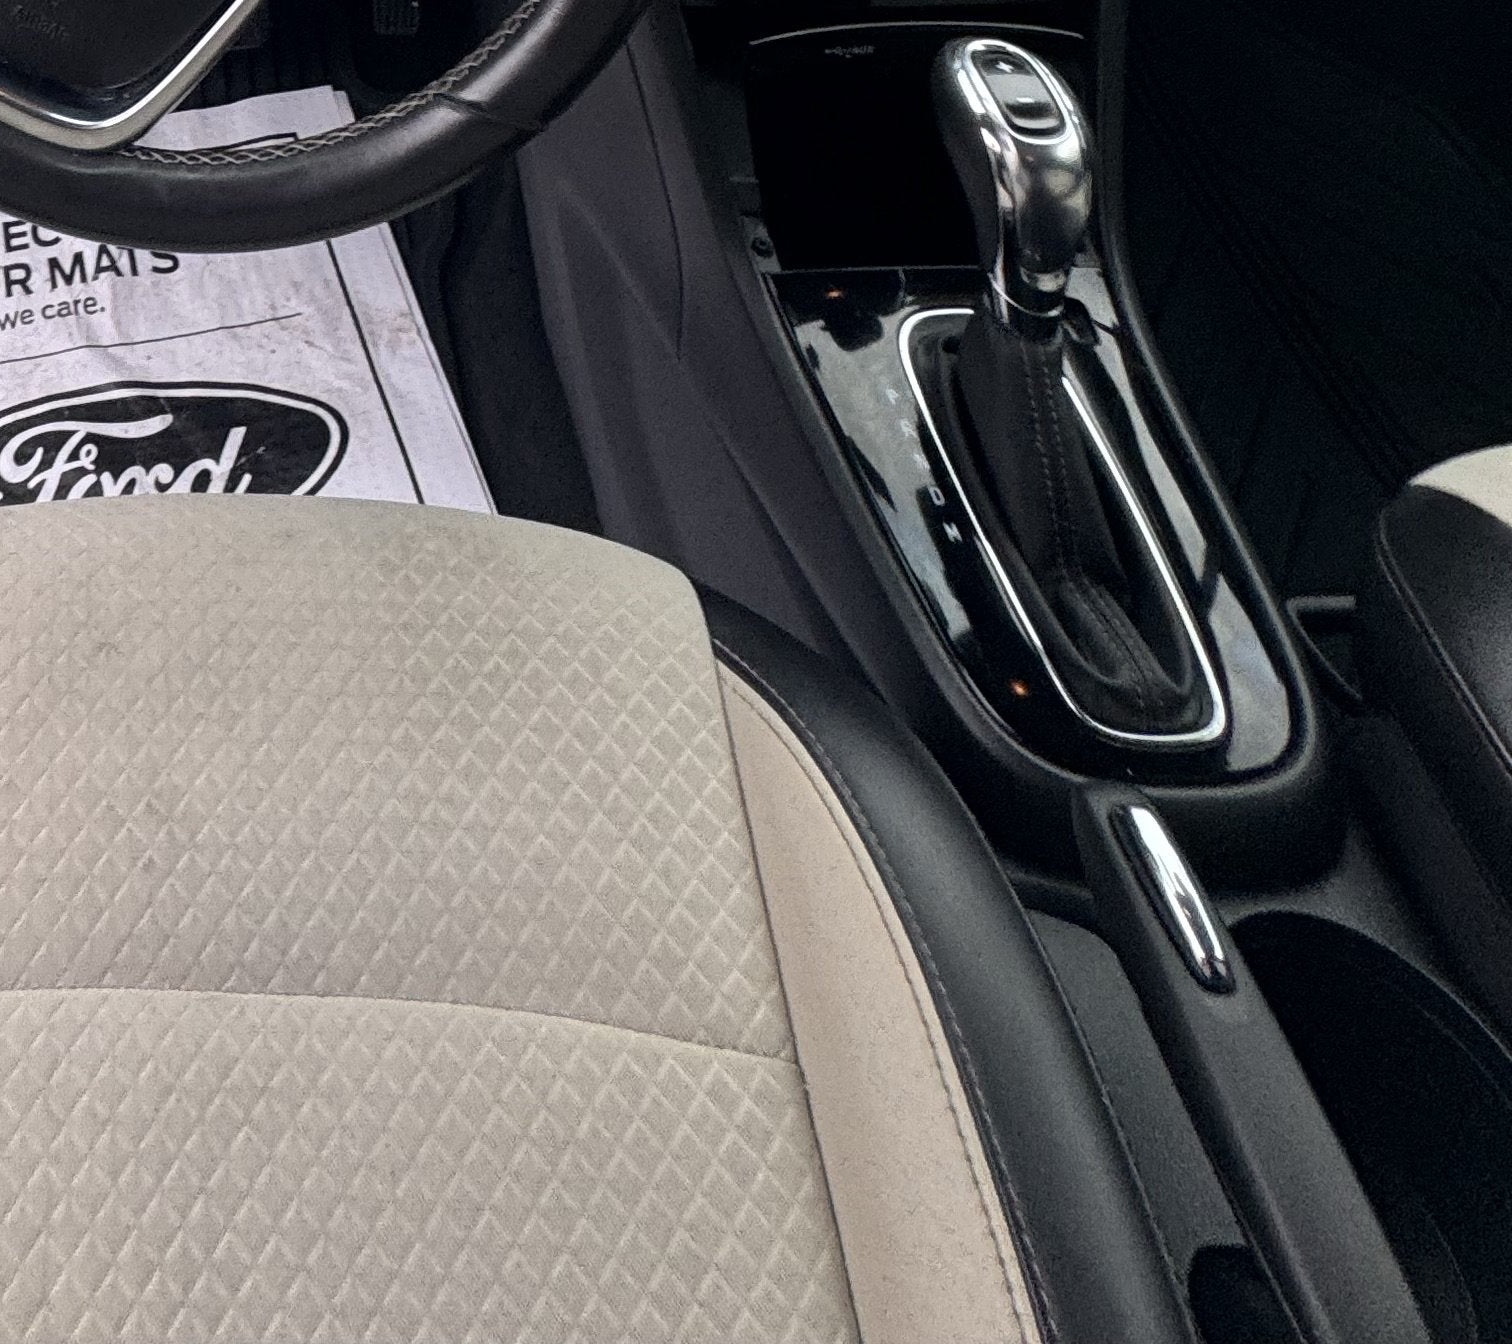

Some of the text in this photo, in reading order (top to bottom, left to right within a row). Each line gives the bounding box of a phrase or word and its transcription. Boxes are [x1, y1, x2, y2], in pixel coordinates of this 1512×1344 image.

[47, 243, 181, 292] MATS
[41, 294, 106, 321] care.
[927, 485, 946, 507] D
